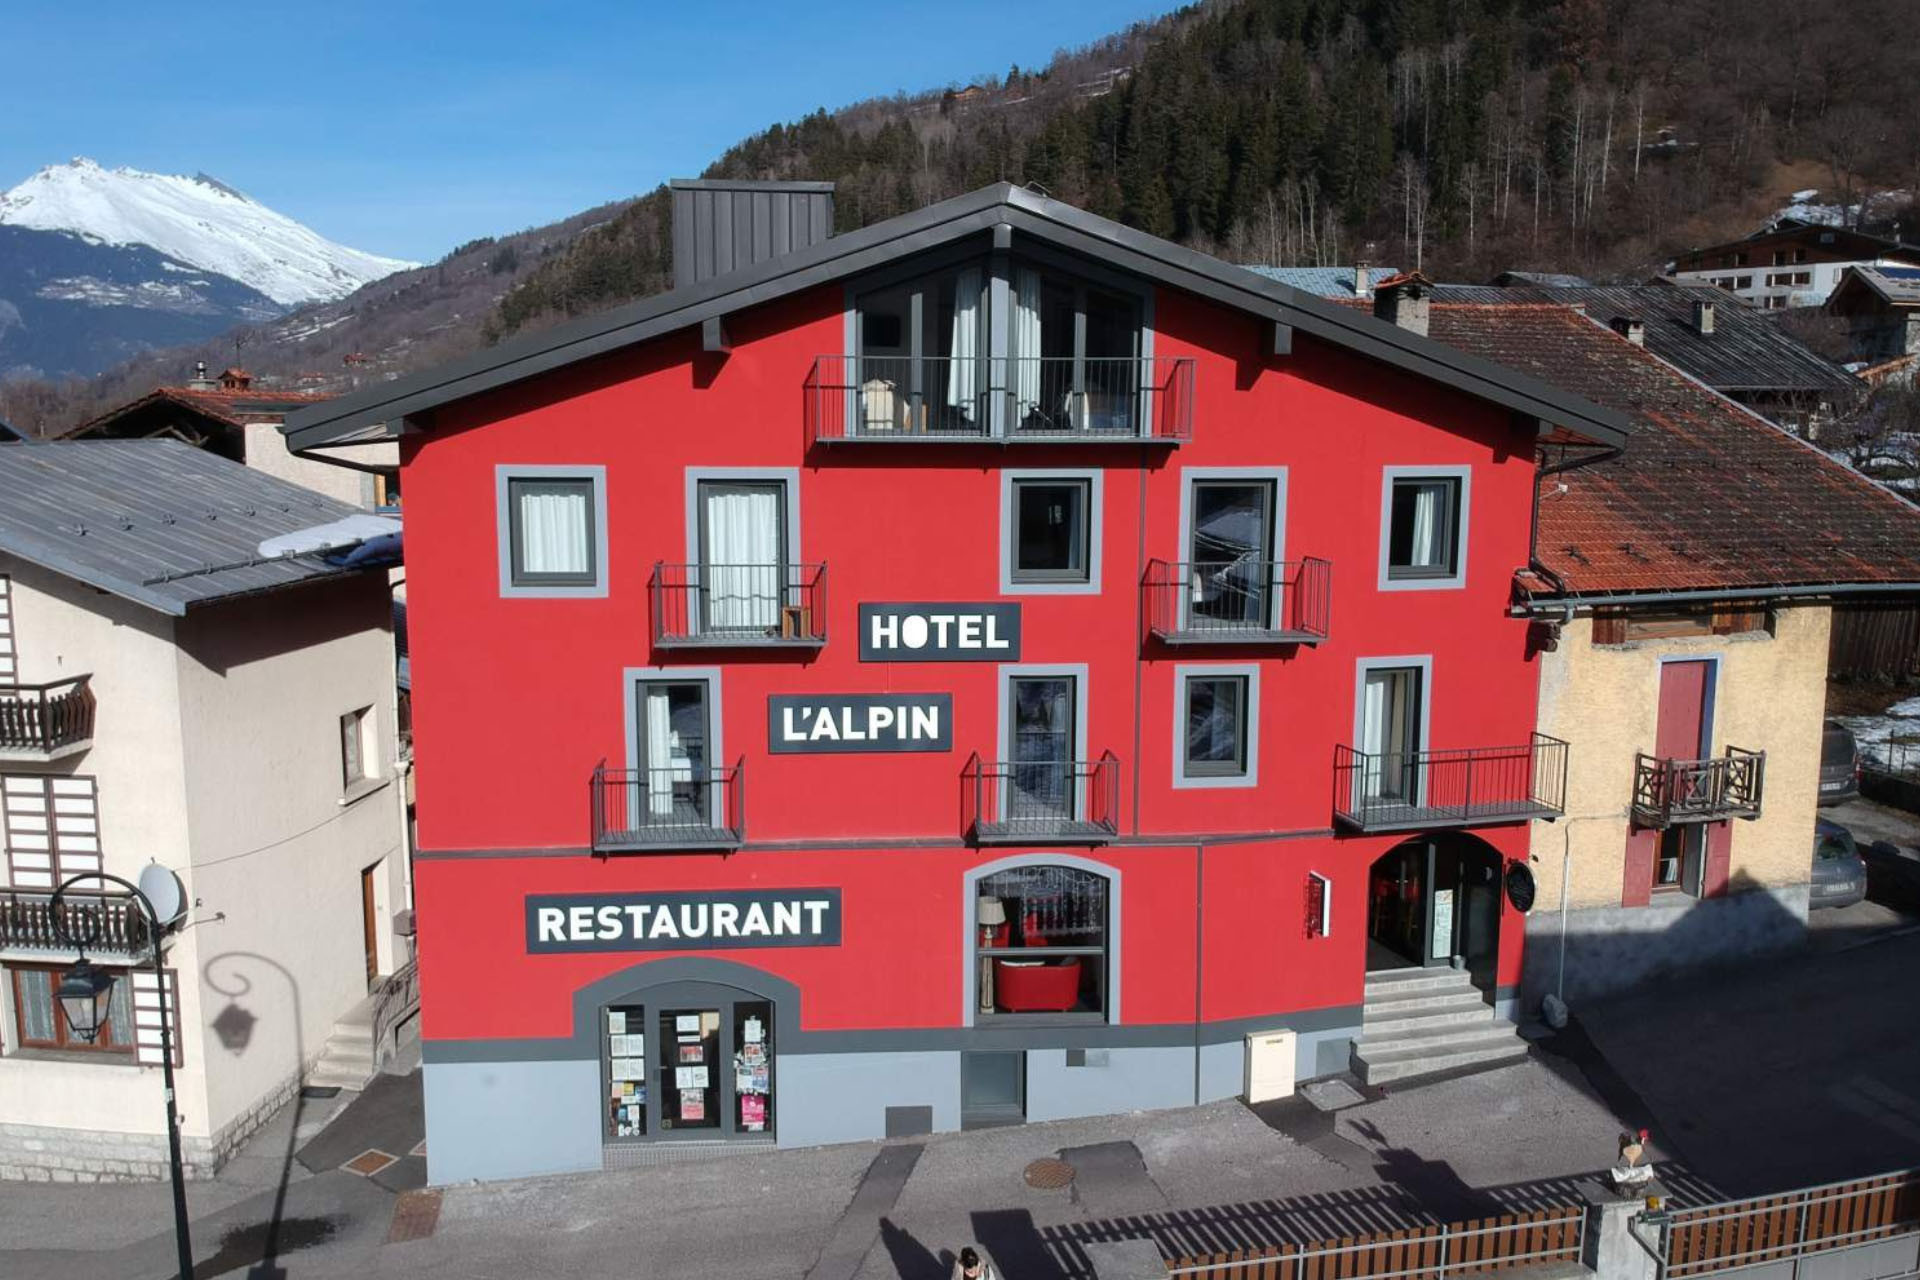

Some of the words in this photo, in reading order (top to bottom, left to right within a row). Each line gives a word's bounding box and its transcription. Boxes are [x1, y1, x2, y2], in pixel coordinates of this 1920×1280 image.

[871, 614, 1009, 649] HOTEL
[783, 705, 939, 741] L'ALPIN
[538, 900, 830, 942] RESTAURANT
